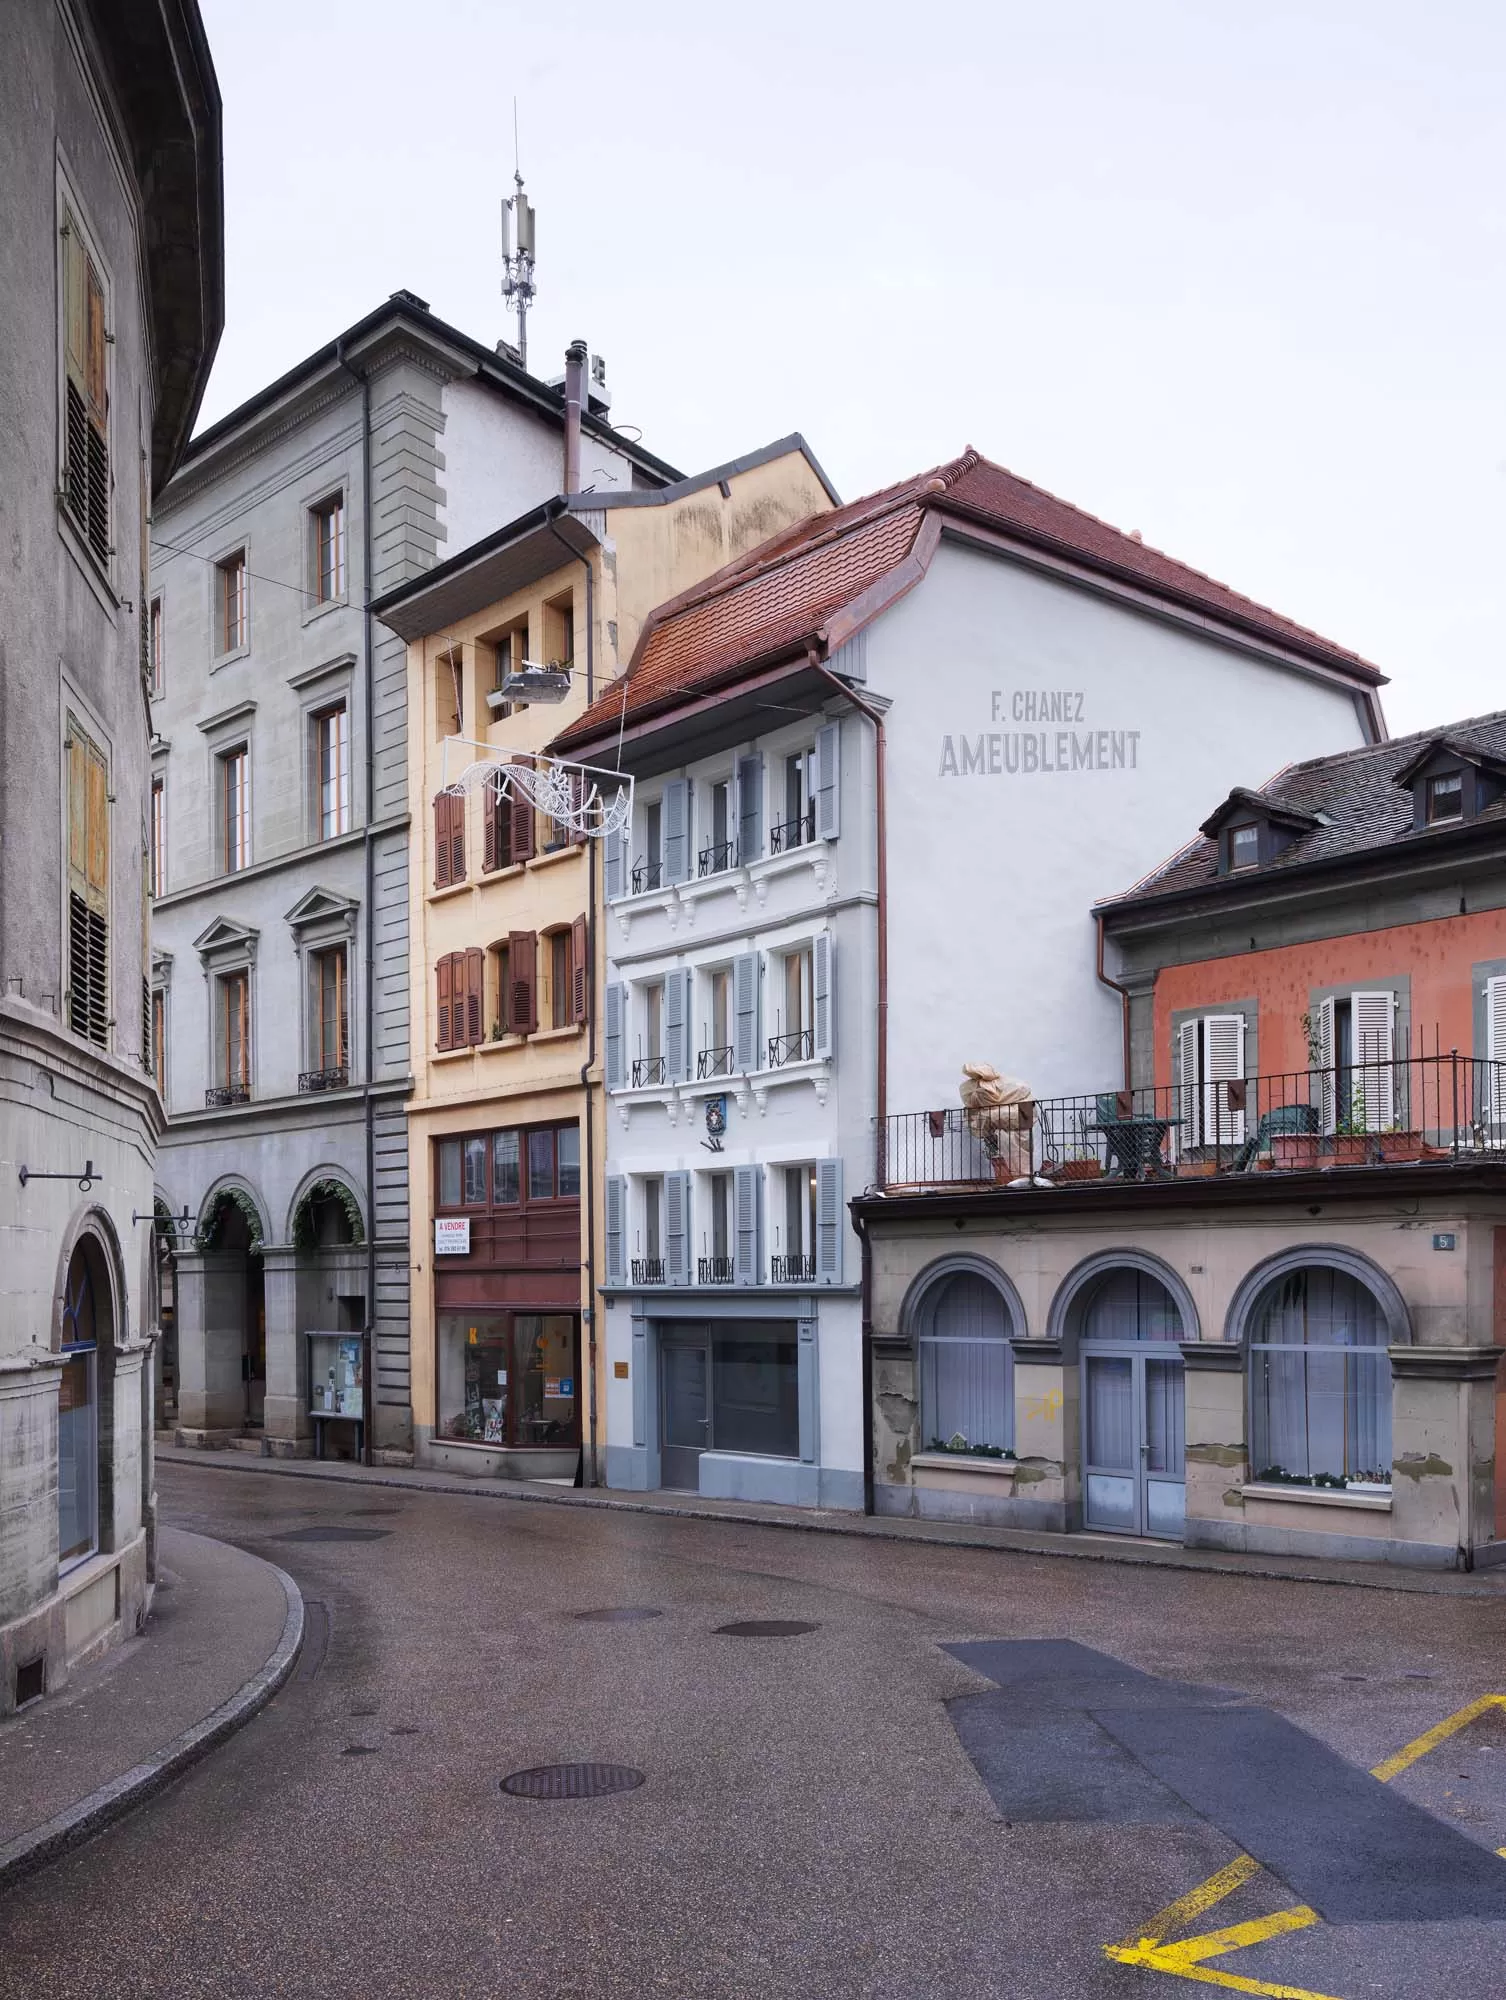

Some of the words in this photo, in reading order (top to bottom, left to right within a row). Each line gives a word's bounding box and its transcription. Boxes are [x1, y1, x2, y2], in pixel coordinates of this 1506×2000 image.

[991, 690, 1006, 722] F.
[1012, 690, 1085, 723] CHANEZ
[938, 730, 1141, 777] AMEUBLEMENT
[1440, 1235, 1448, 1248] 5
